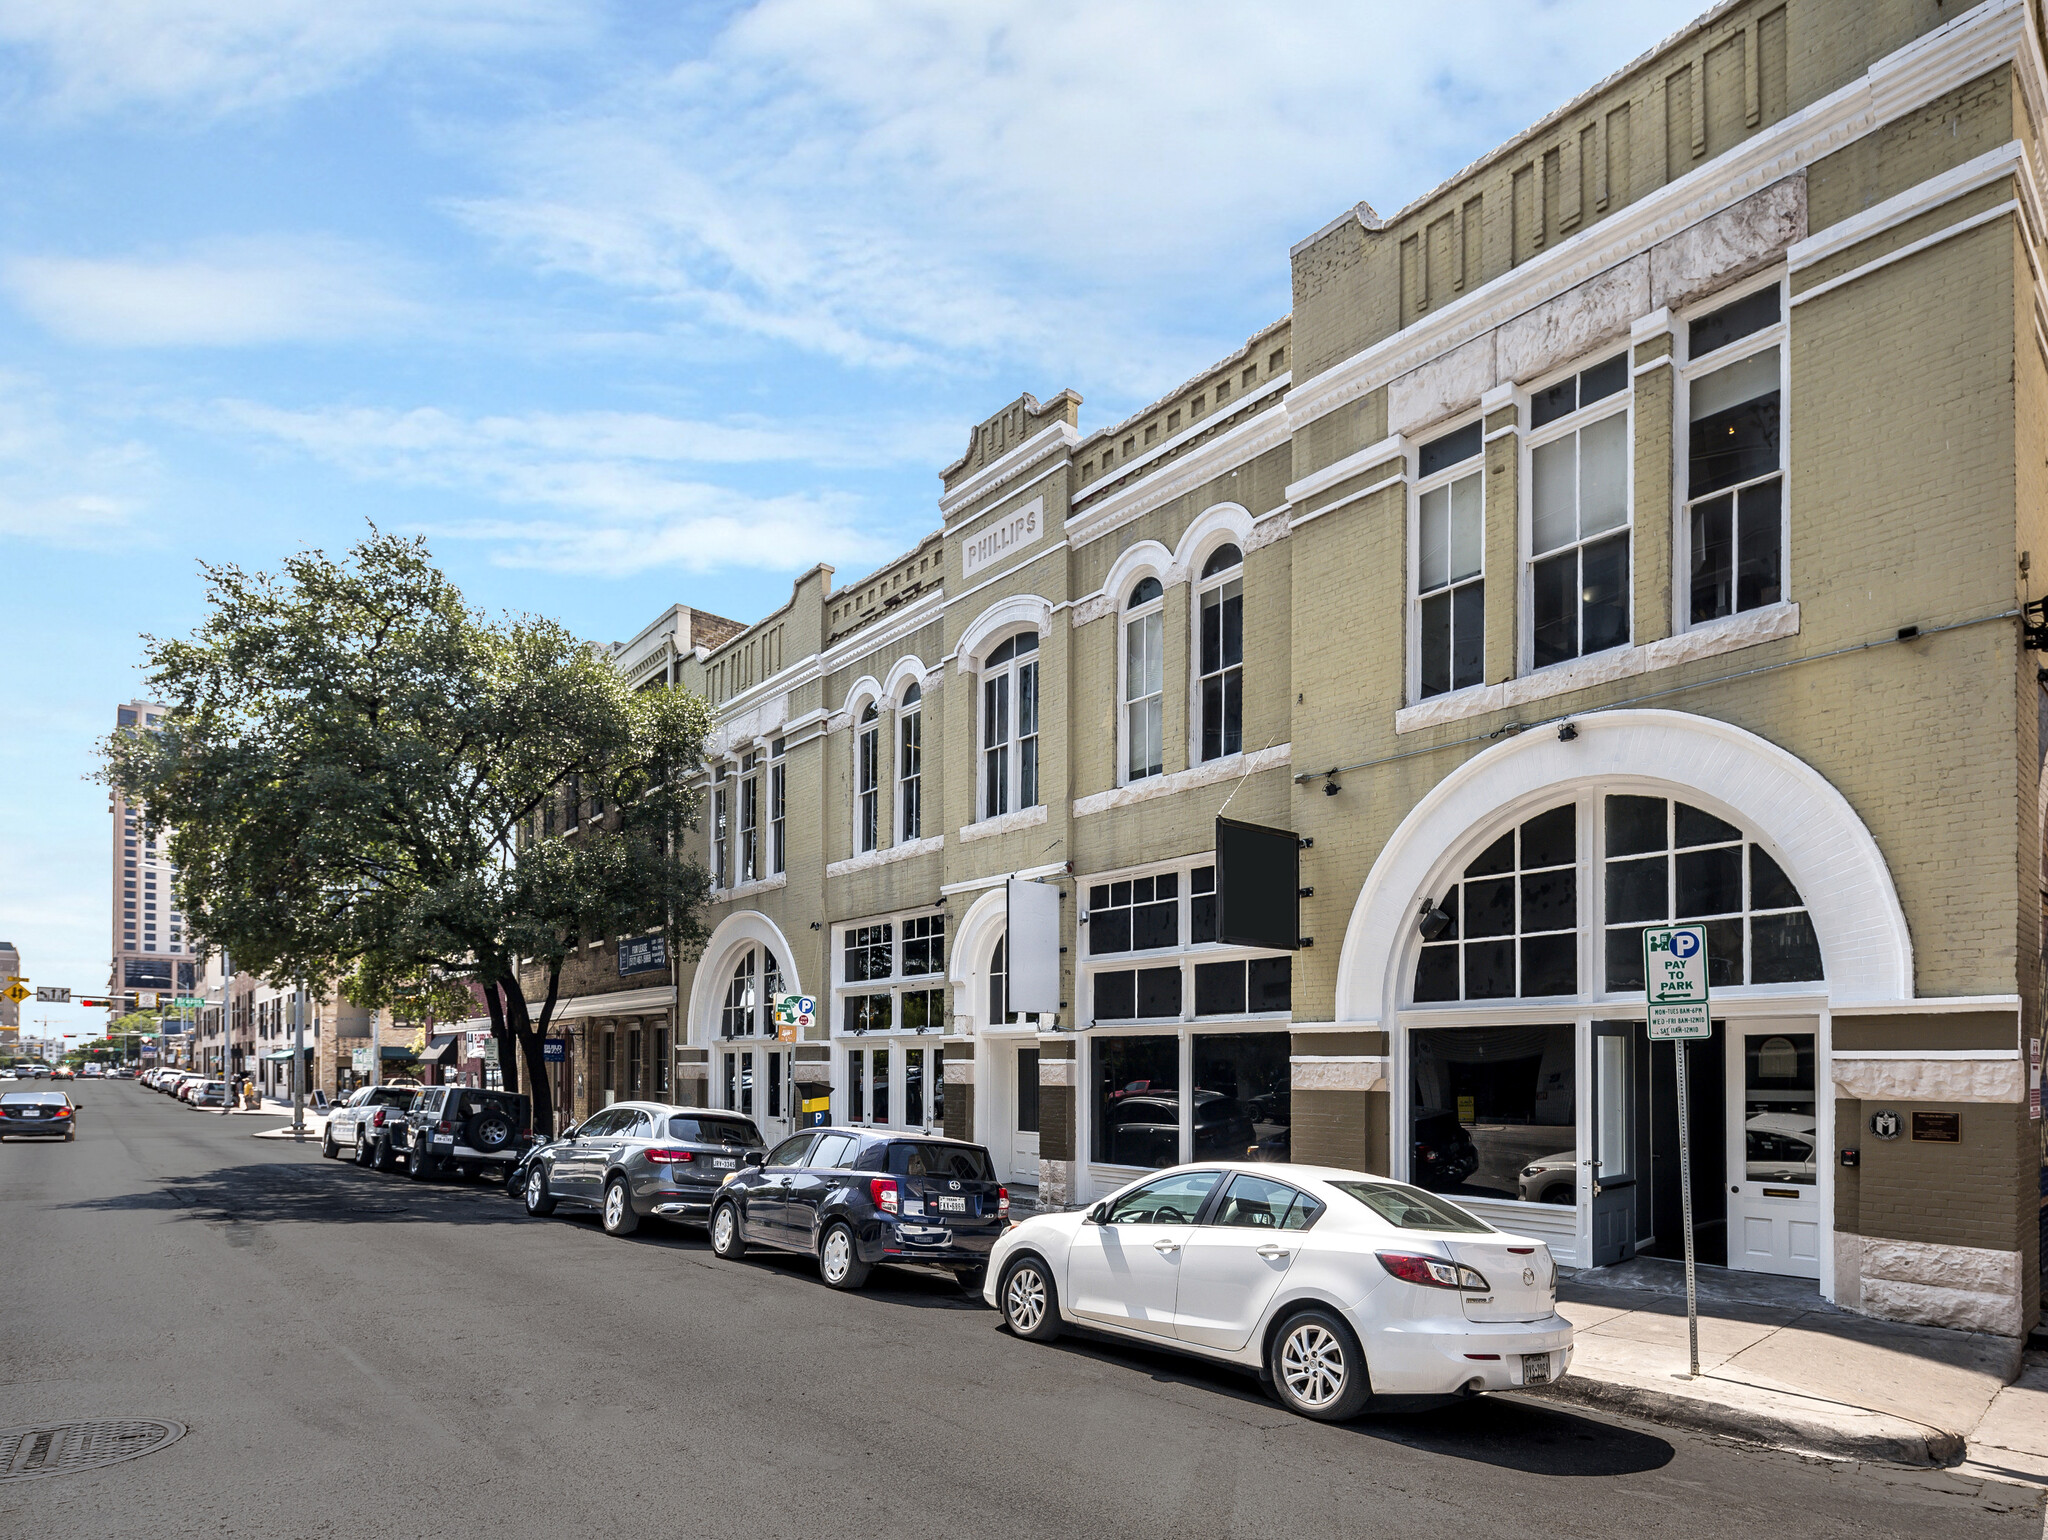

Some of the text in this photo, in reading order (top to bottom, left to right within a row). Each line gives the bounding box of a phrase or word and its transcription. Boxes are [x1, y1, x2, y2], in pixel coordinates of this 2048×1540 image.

[968, 511, 1037, 568] PHILLIPS
[1676, 935, 1694, 956] P
[1665, 960, 1687, 970] PAY
[1668, 971, 1684, 980] TO
[1660, 981, 1694, 991] PARK
[801, 1000, 812, 1012] P
